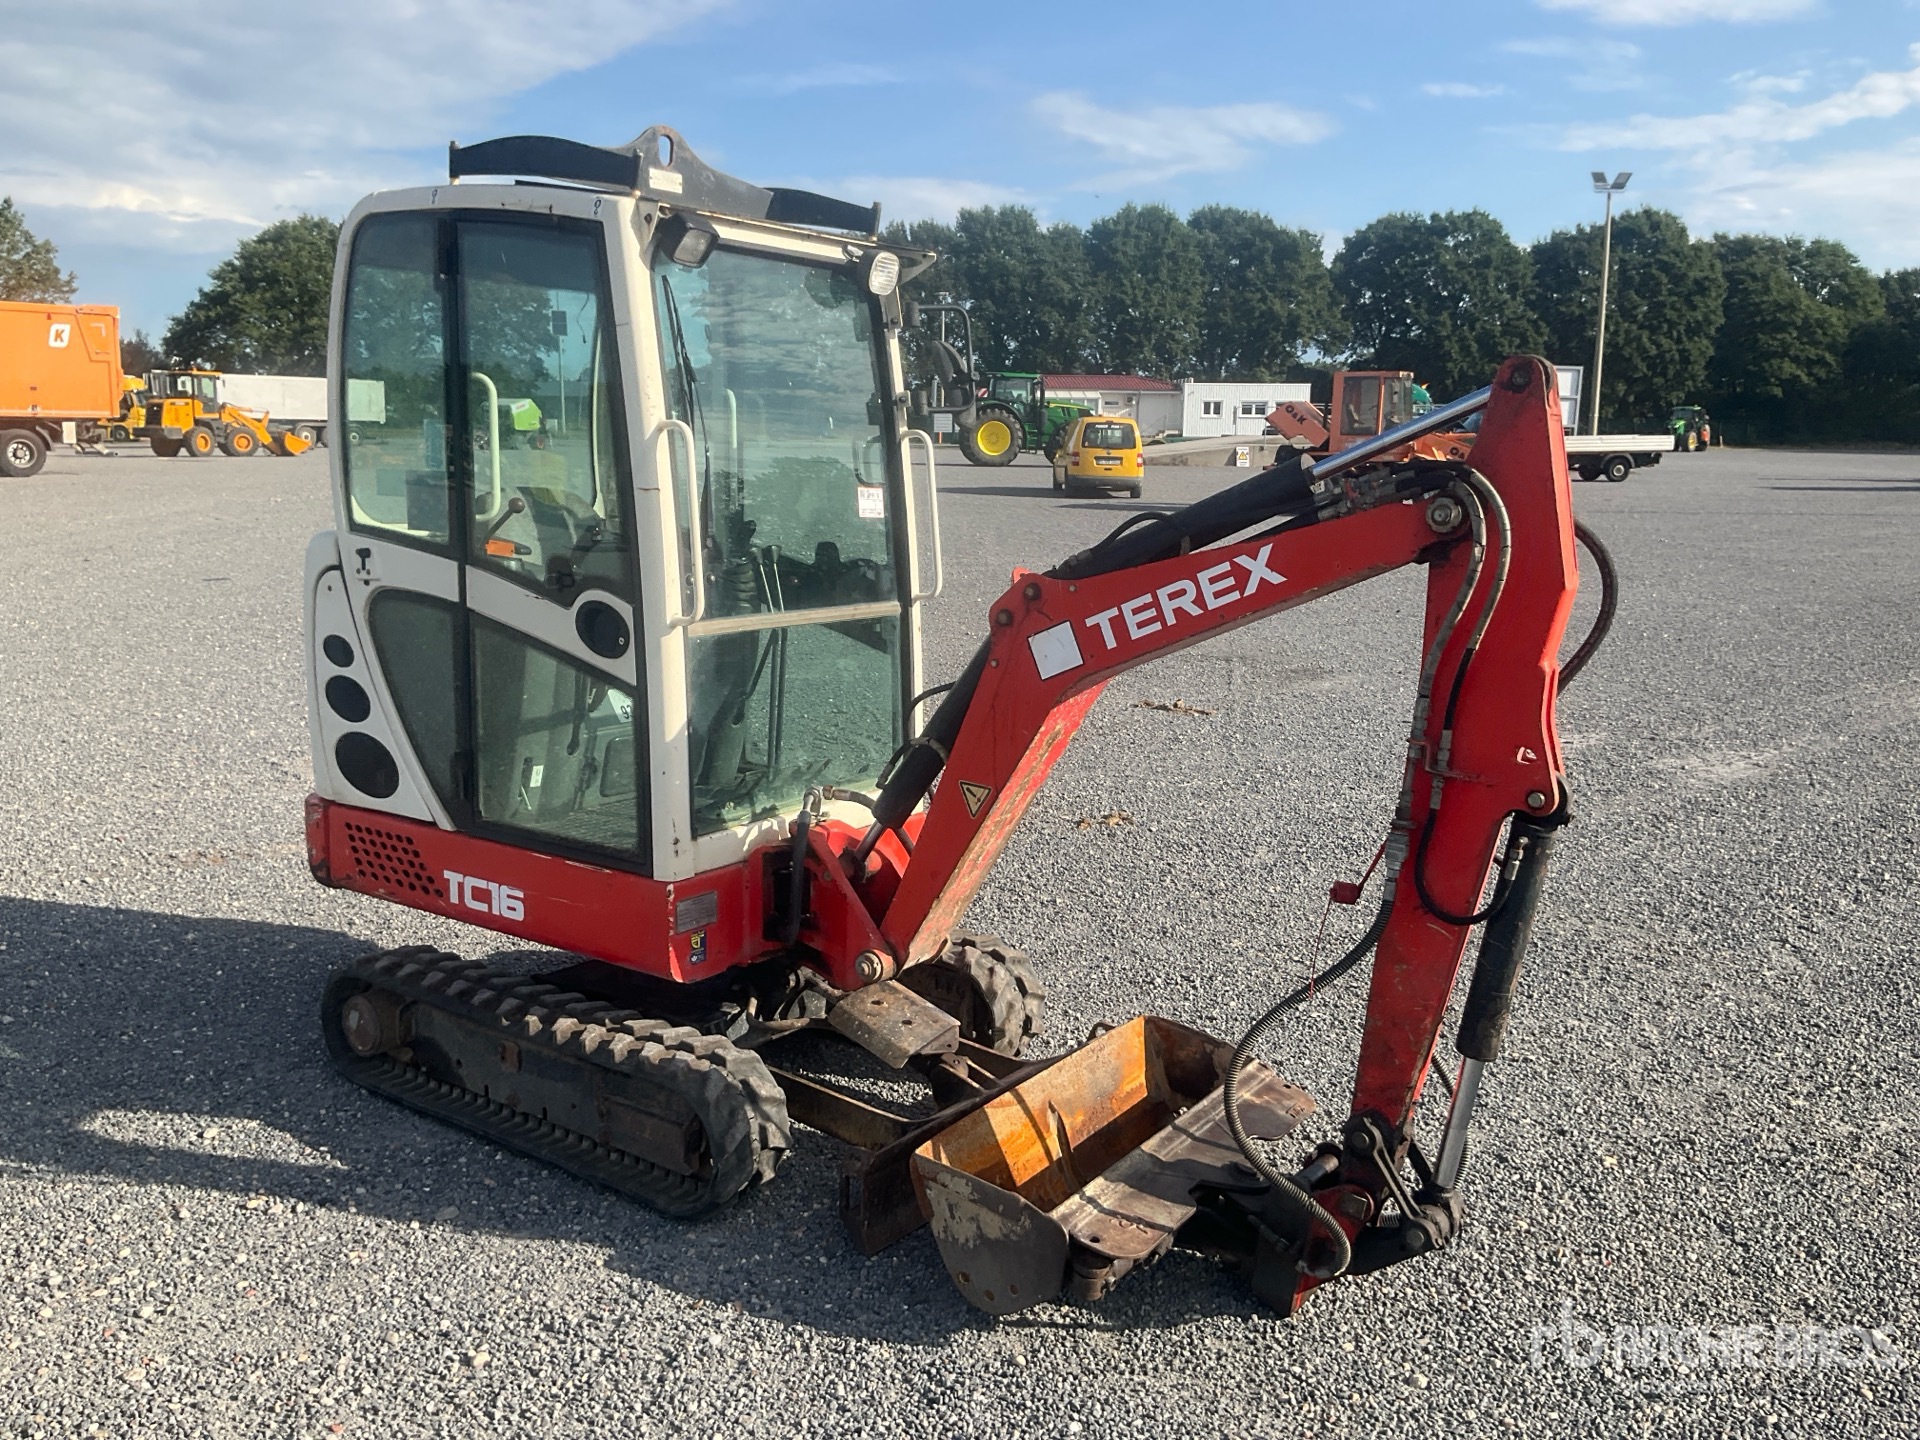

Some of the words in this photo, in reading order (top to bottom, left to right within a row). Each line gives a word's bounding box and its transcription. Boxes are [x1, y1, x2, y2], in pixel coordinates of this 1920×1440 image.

[54, 329, 65, 343] K
[1085, 543, 1288, 650] TEREX
[443, 869, 525, 922] TC16
